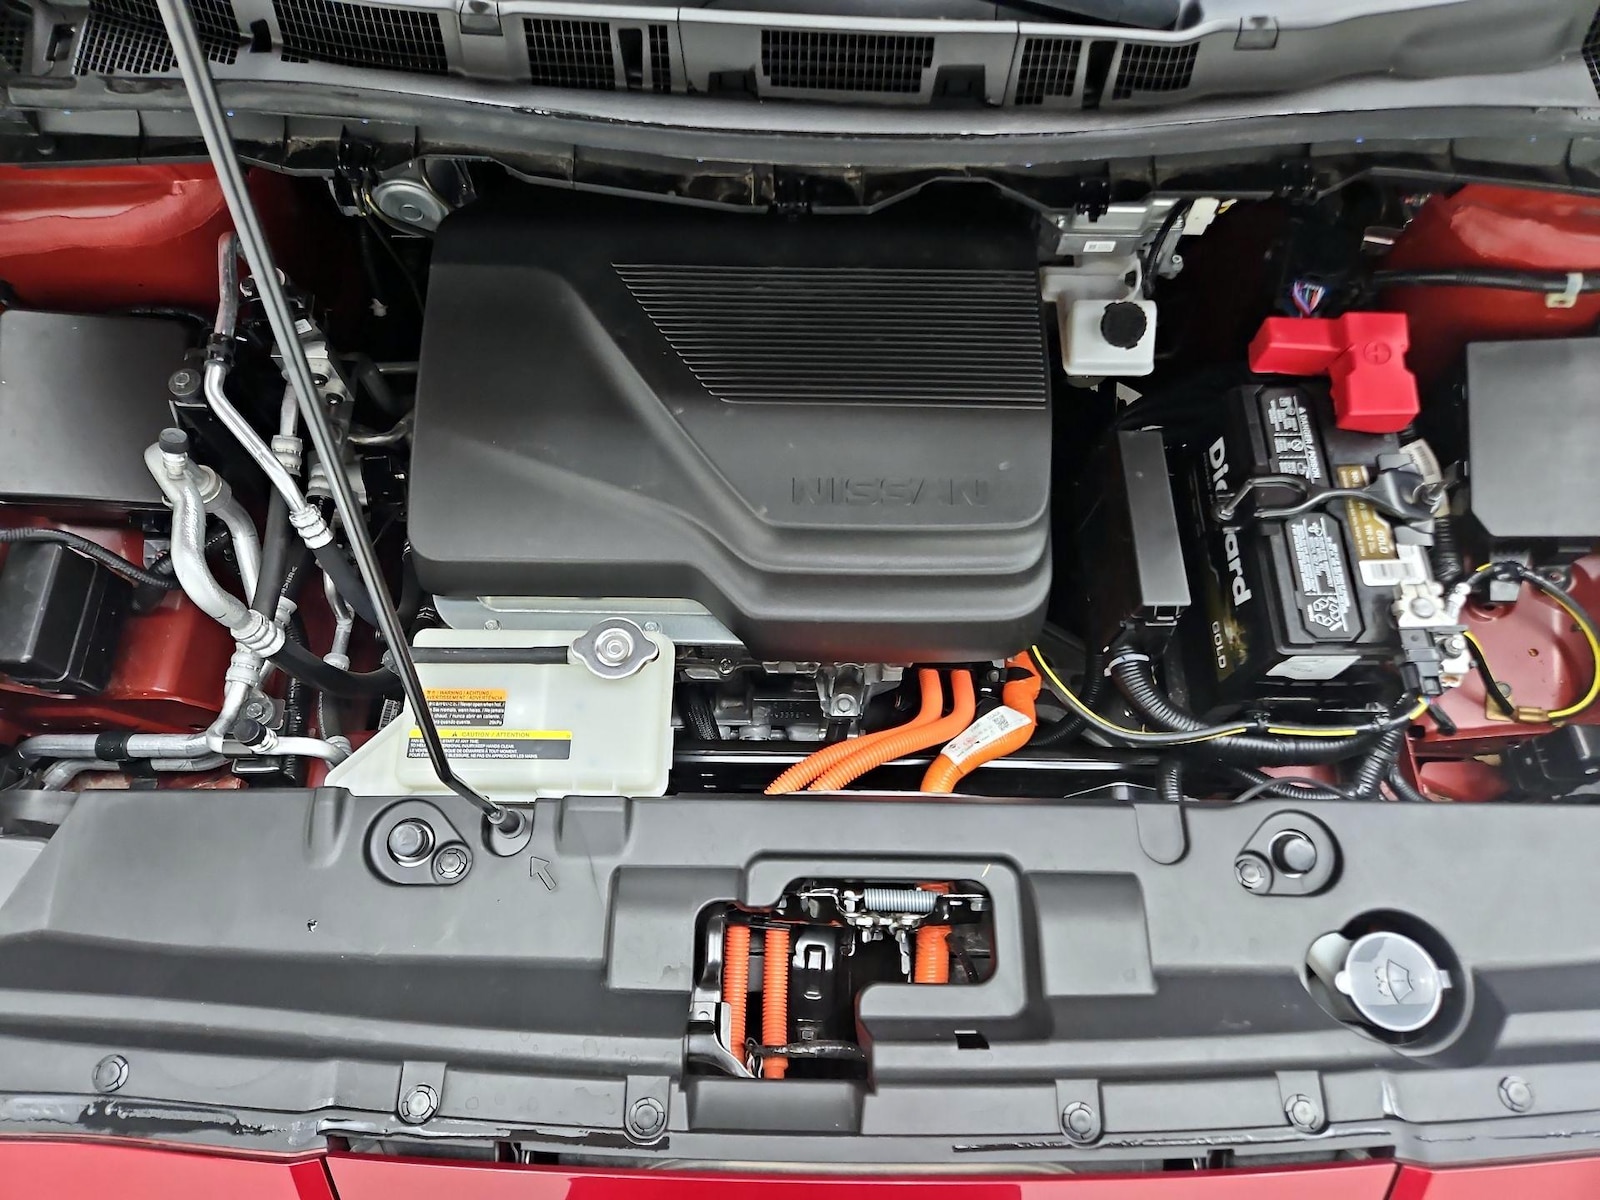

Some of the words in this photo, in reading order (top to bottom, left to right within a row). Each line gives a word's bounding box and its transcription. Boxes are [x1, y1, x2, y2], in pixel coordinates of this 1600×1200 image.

[792, 476, 989, 506] NISSAN
[1376, 529, 1389, 554] GOLD
[1211, 620, 1227, 669] GOLD
